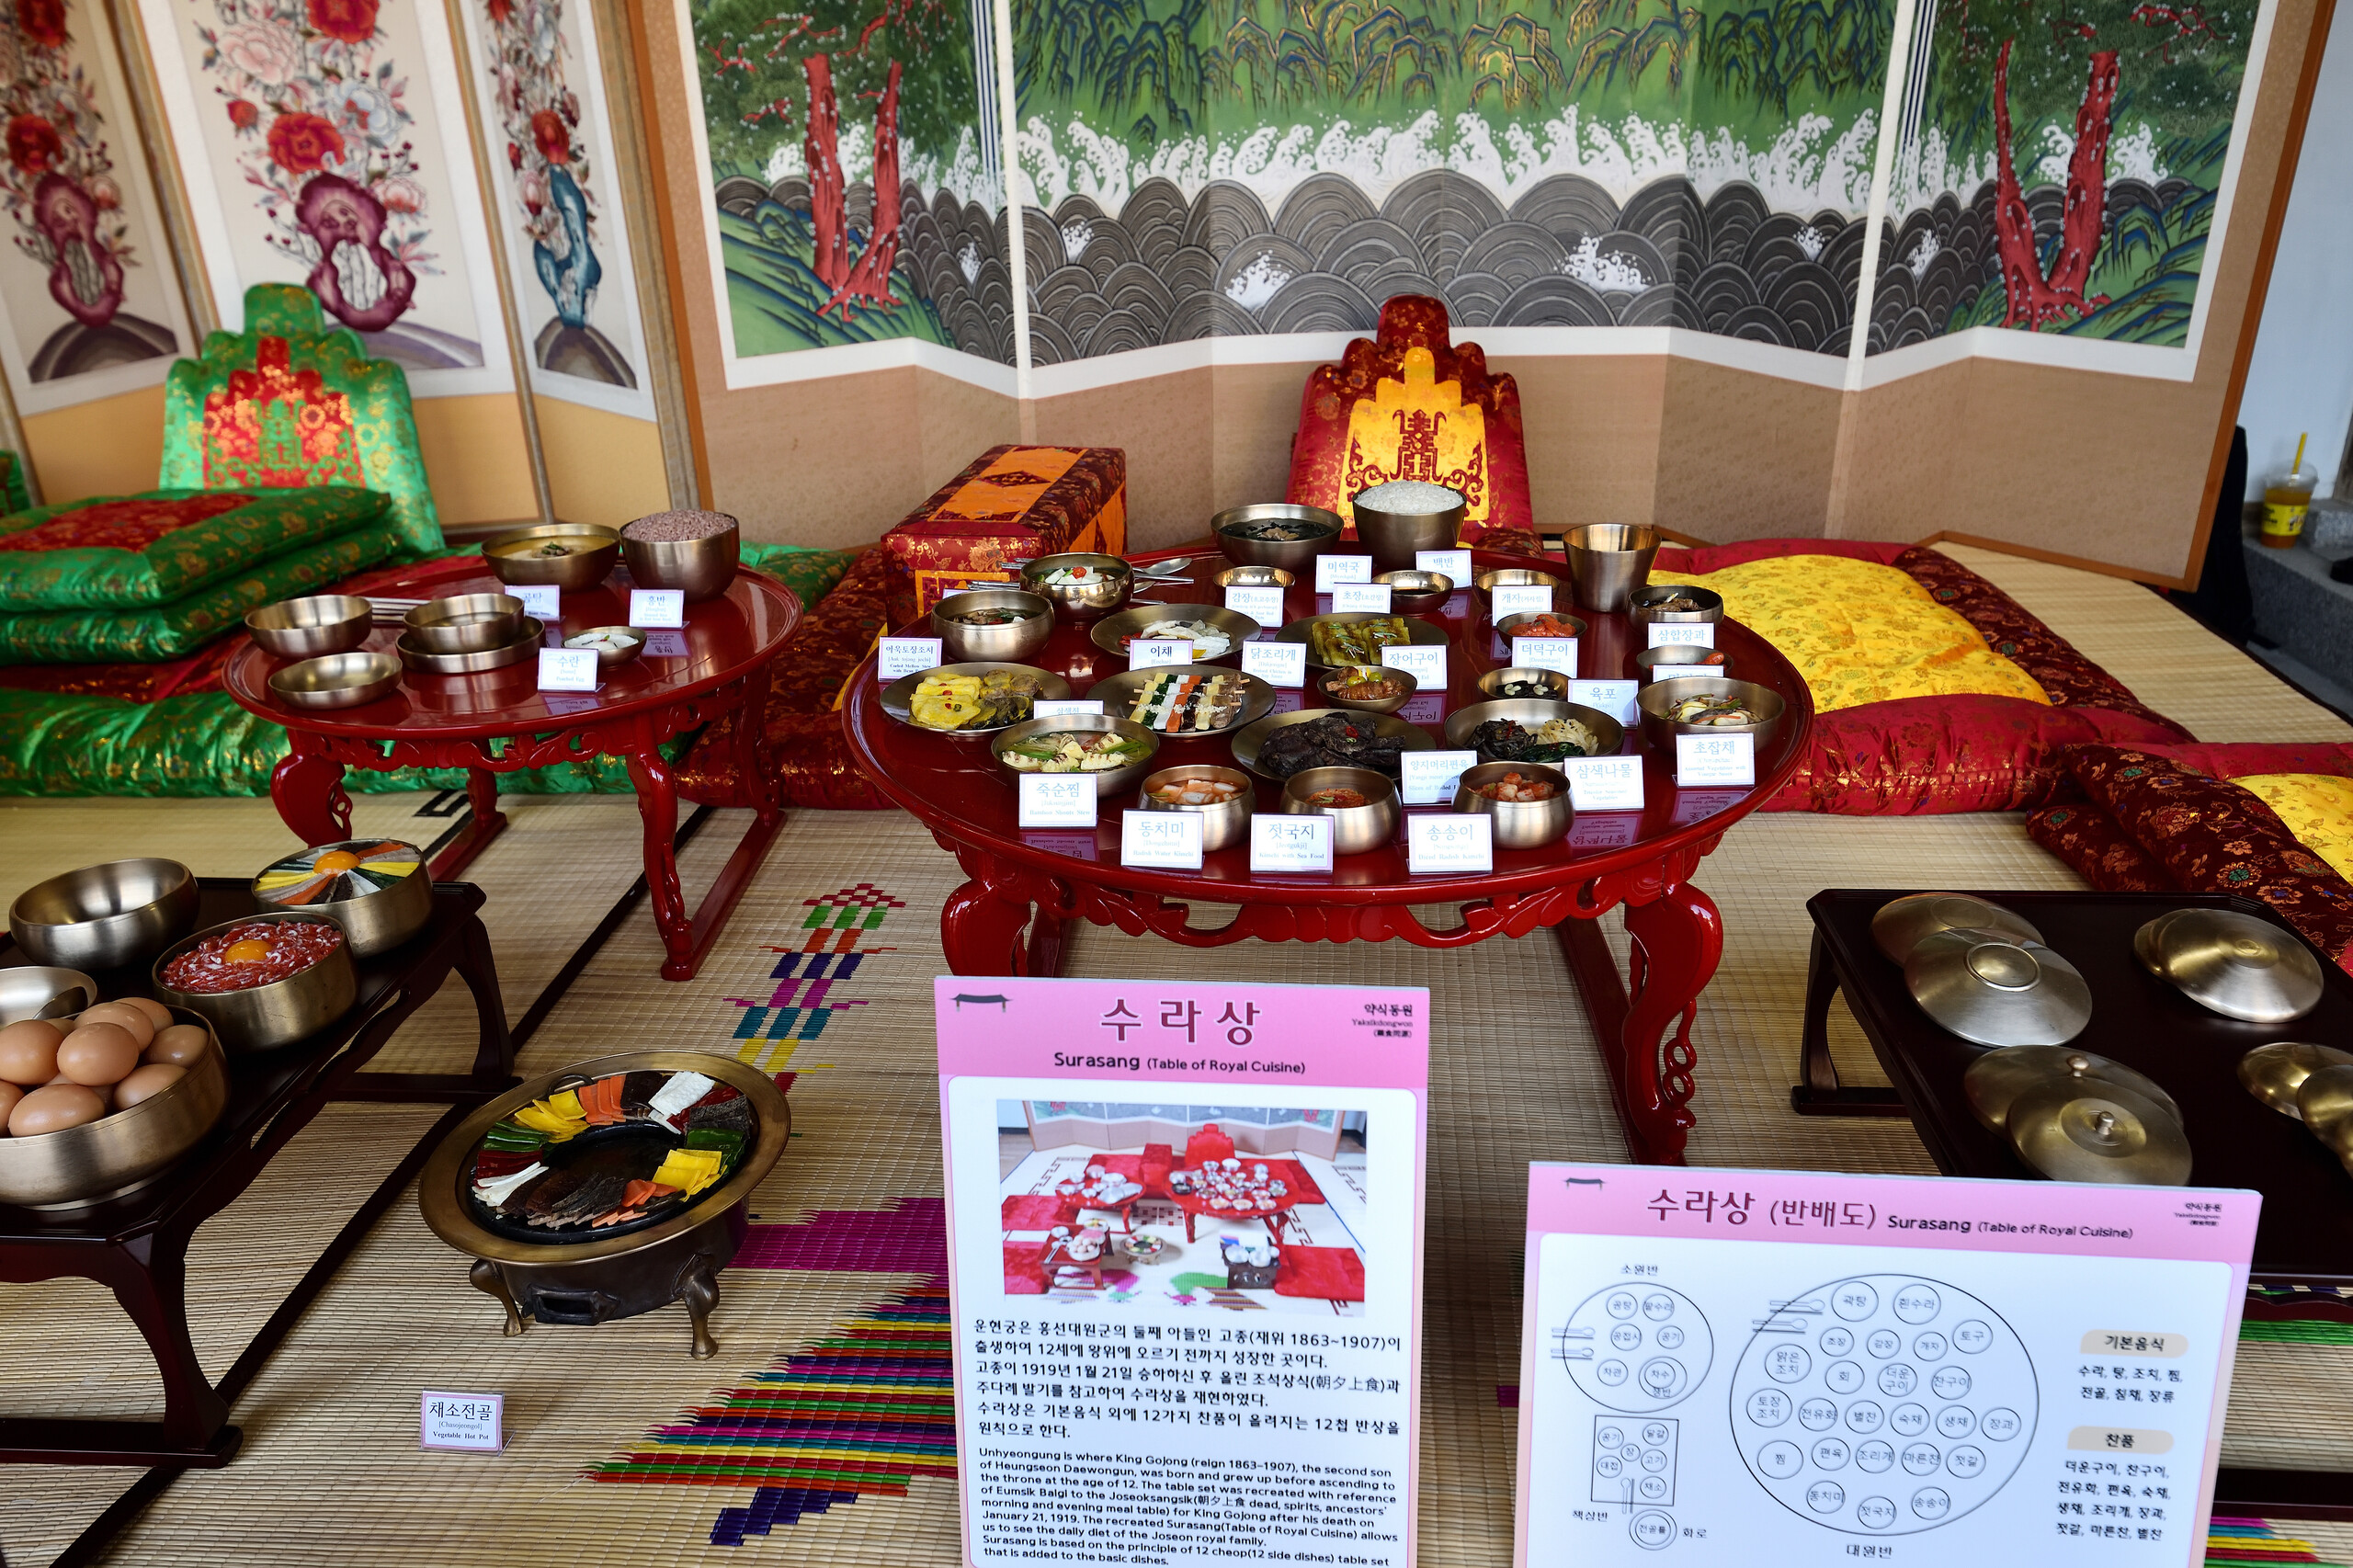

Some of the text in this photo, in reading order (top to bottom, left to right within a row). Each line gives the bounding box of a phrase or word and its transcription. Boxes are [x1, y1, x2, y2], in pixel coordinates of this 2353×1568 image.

[1433, 557, 1454, 568] 백반
[1658, 629, 1706, 642] 삼합장과
[1251, 647, 1296, 662] 닭조리개
[1521, 643, 1568, 656] 더덕구이
[557, 655, 580, 668] 수란
[1389, 652, 1438, 665] 장어구이
[1590, 687, 1617, 700] 육포
[1693, 741, 1735, 755] 초잡채
[1577, 763, 1633, 779] 삼색나물
[1036, 782, 1080, 798] 죽순찜
[1138, 821, 1184, 838] 동치미
[1267, 824, 1314, 840] 젓국지
[1427, 824, 1473, 841] 송송이
[1364, 1003, 1413, 1017] 약식동원
[1053, 1051, 1306, 1074] Surasang (Table of Royal Cuisine)
[1646, 1188, 2133, 1239] 수라상 (반배도) Surasang (Table of Royal Cuisine)
[973, 1318, 1401, 1352] 운현궁은 흥선대원군의 둘째 아들인 고종(재위 1863~1907)이
[2105, 1335, 2165, 1352] 기본음식
[974, 1339, 1327, 1369] 출생하여 12세에 왕위에 오르기 전까지 성장한 곳이다.
[975, 1359, 1017, 1376] 고종이
[1021, 1362, 1071, 1379] 1919년
[1074, 1364, 1097, 1379] 1월
[1101, 1365, 1132, 1381] 21일
[1137, 1367, 1194, 1384] 승하하신
[1199, 1369, 1212, 1384] 후
[976, 1381, 1268, 1408] 주다례 발기를 참고하여 수라상을 재현하였다.
[429, 1401, 493, 1421] 채소전골
[977, 1401, 1036, 1417] 수라상은
[1043, 1403, 1101, 1420] 기본음식
[1108, 1406, 1137, 1422] 외에
[1142, 1409, 1190, 1425] 12가지
[1314, 1417, 1348, 1433] 12첩
[1355, 1419, 1400, 1435] 반상을
[433, 1431, 461, 1439] Vegetable
[978, 1421, 1071, 1439] 원칙으로 한다.
[978, 1447, 1062, 1461] Unhyeongung
[1063, 1450, 1073, 1461] is
[1074, 1451, 1113, 1463] where
[1115, 1453, 1142, 1466] King
[1144, 1454, 1188, 1468] Gojong
[1190, 1457, 1226, 1470] (reign
[1301, 1463, 1322, 1474] the
[1324, 1466, 1368, 1477] second
[1370, 1469, 1392, 1478] son
[979, 1460, 1395, 1492] of Heungseon Daewongun, was born and grew up before ascending to
[983, 1546, 1169, 1565] that is added to the basic dishes.
